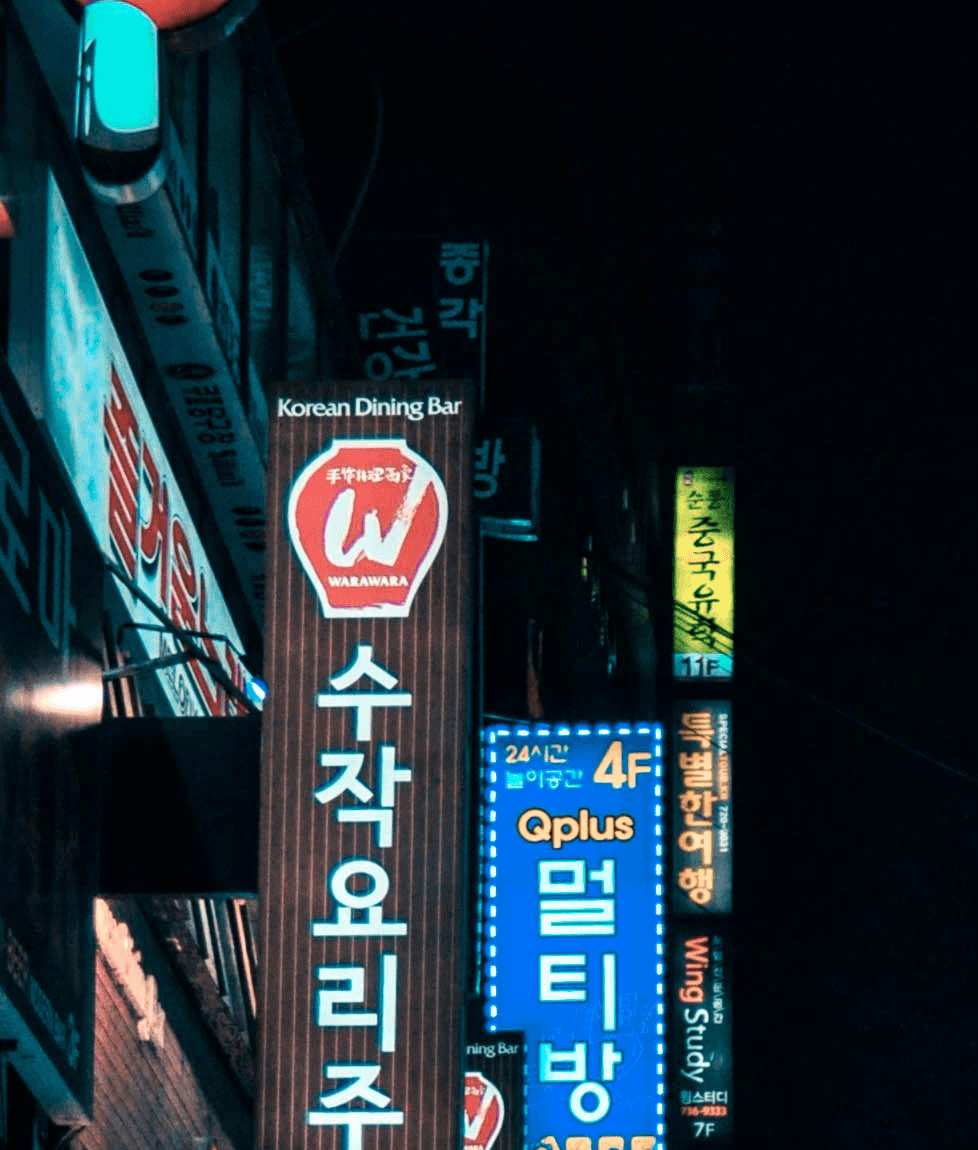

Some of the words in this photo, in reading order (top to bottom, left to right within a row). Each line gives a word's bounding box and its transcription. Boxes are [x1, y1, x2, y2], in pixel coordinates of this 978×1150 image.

[277, 398, 351, 417] Korean
[355, 397, 425, 421] Dining
[428, 396, 463, 415] Bar
[328, 575, 408, 588] WARAWARA
[682, 655, 720, 676] 11F
[505, 744, 570, 764] 24시간
[594, 741, 652, 790] 4F
[505, 768, 584, 789] 놀이공간
[517, 808, 635, 849] Qplus
[679, 935, 709, 1004] Wing
[537, 858, 624, 1124] 멀티방
[466, 1043, 496, 1057] ning
[498, 1042, 519, 1054] Bar
[680, 1008, 711, 1083] Study
[693, 1122, 716, 1137] 7F
